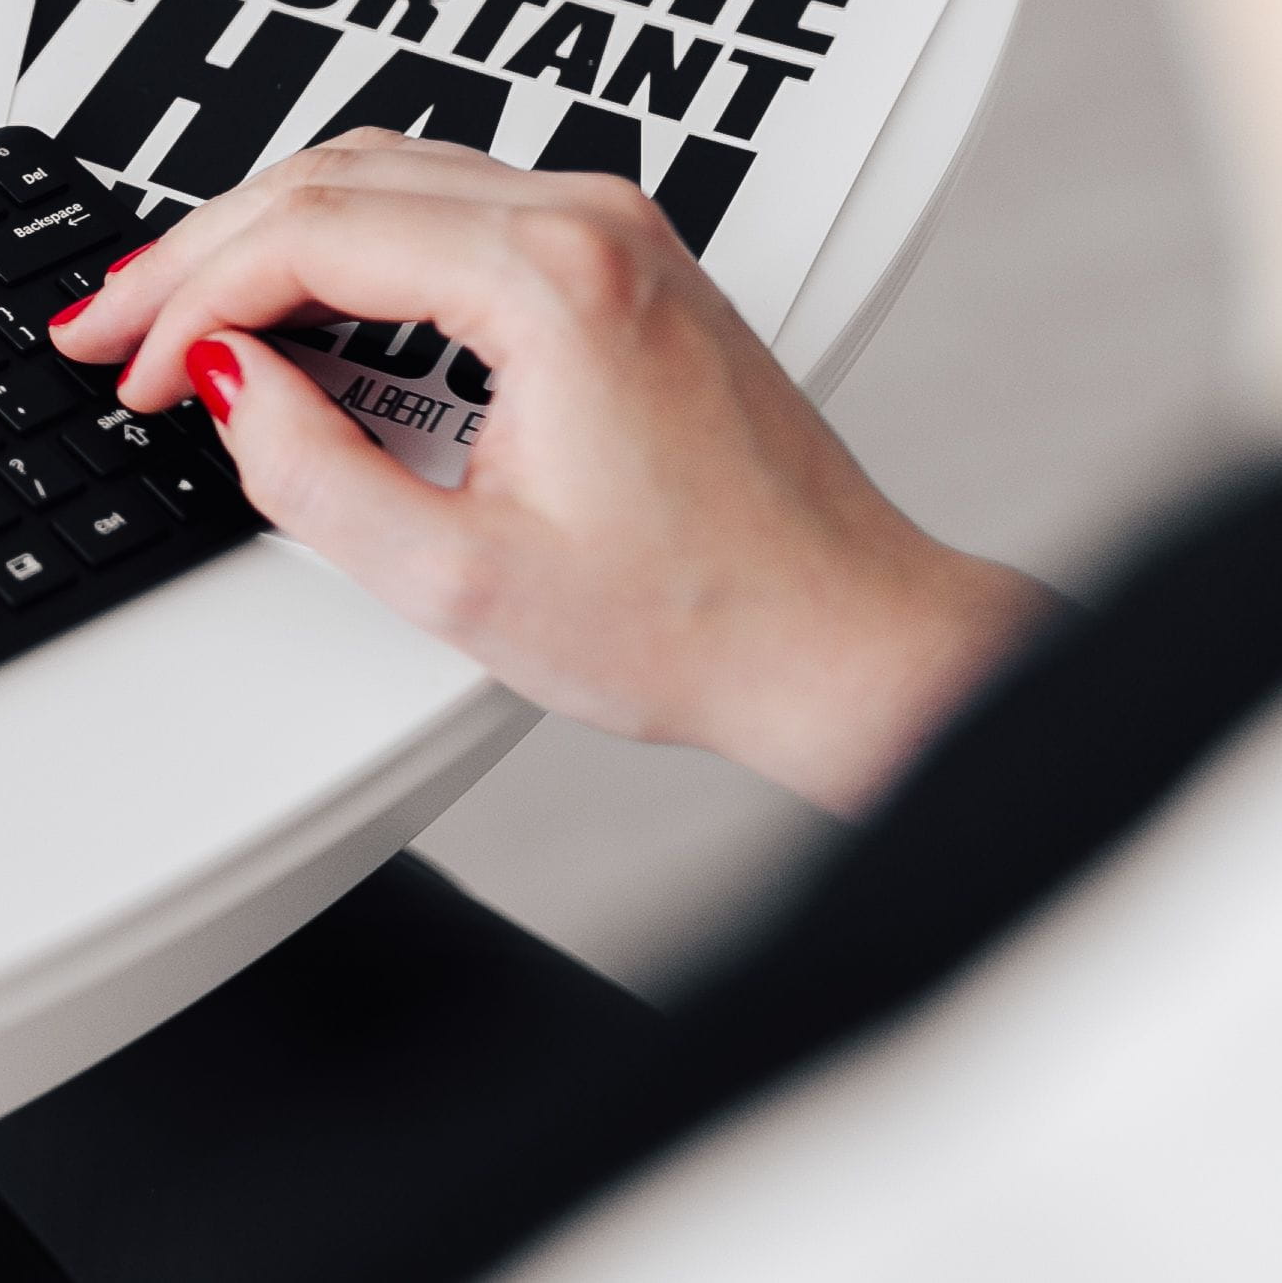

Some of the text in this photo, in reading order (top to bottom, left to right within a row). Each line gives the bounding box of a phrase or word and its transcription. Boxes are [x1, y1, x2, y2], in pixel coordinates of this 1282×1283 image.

[21, 167, 49, 185] Del
[12, 202, 85, 238] Backspace
[339, 374, 453, 434] ALBERT
[96, 408, 134, 430] Shift
